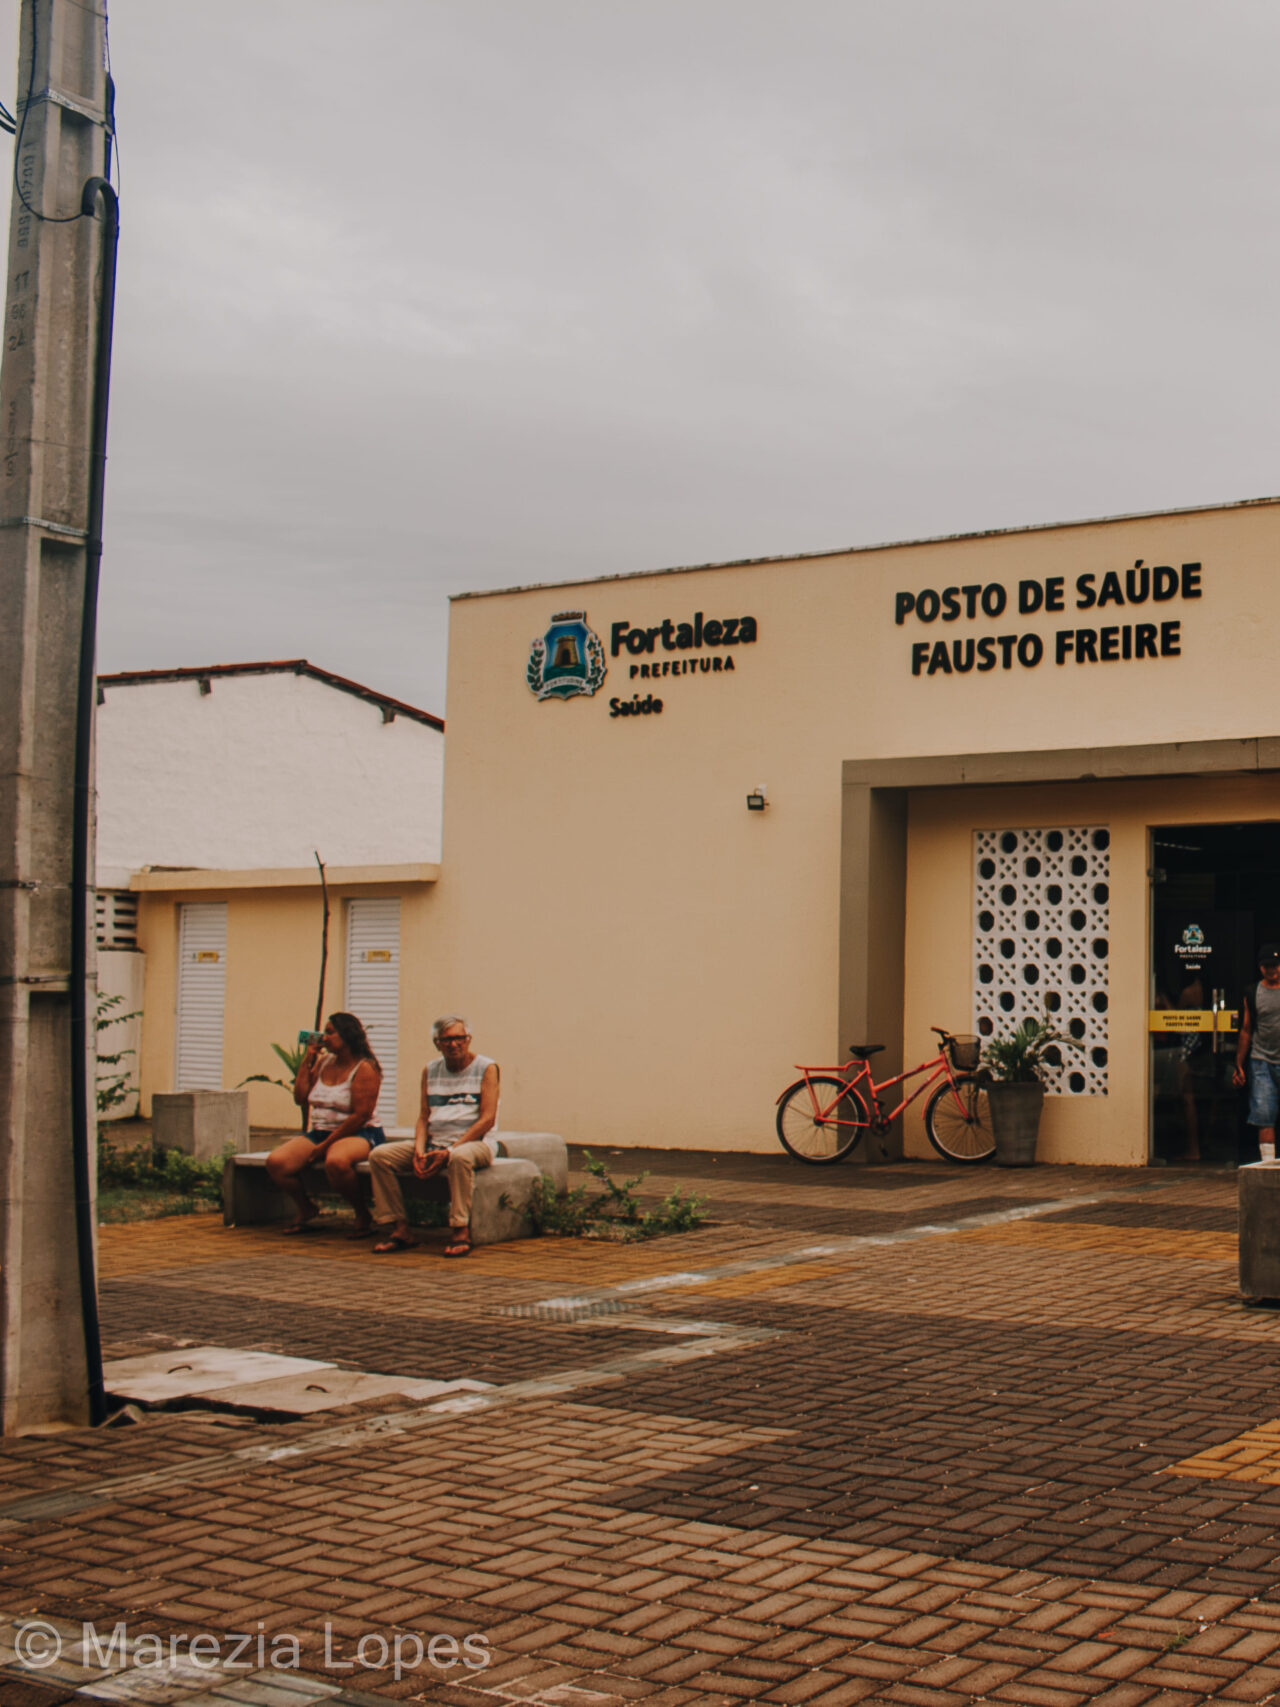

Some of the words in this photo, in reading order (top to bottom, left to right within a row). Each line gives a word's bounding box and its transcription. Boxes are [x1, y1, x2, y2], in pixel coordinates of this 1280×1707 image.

[895, 582, 1007, 625] POSTO
[1018, 576, 1065, 614] DE
[1075, 559, 1202, 610] SAÚDE
[610, 612, 758, 657] Fortaleza
[911, 633, 1043, 676] FAUSTO
[1055, 620, 1181, 665] FREIRE
[629, 656, 735, 679] PREFEITURA
[609, 694, 664, 718] Saúde
[1174, 944, 1212, 953] Fortaleza
